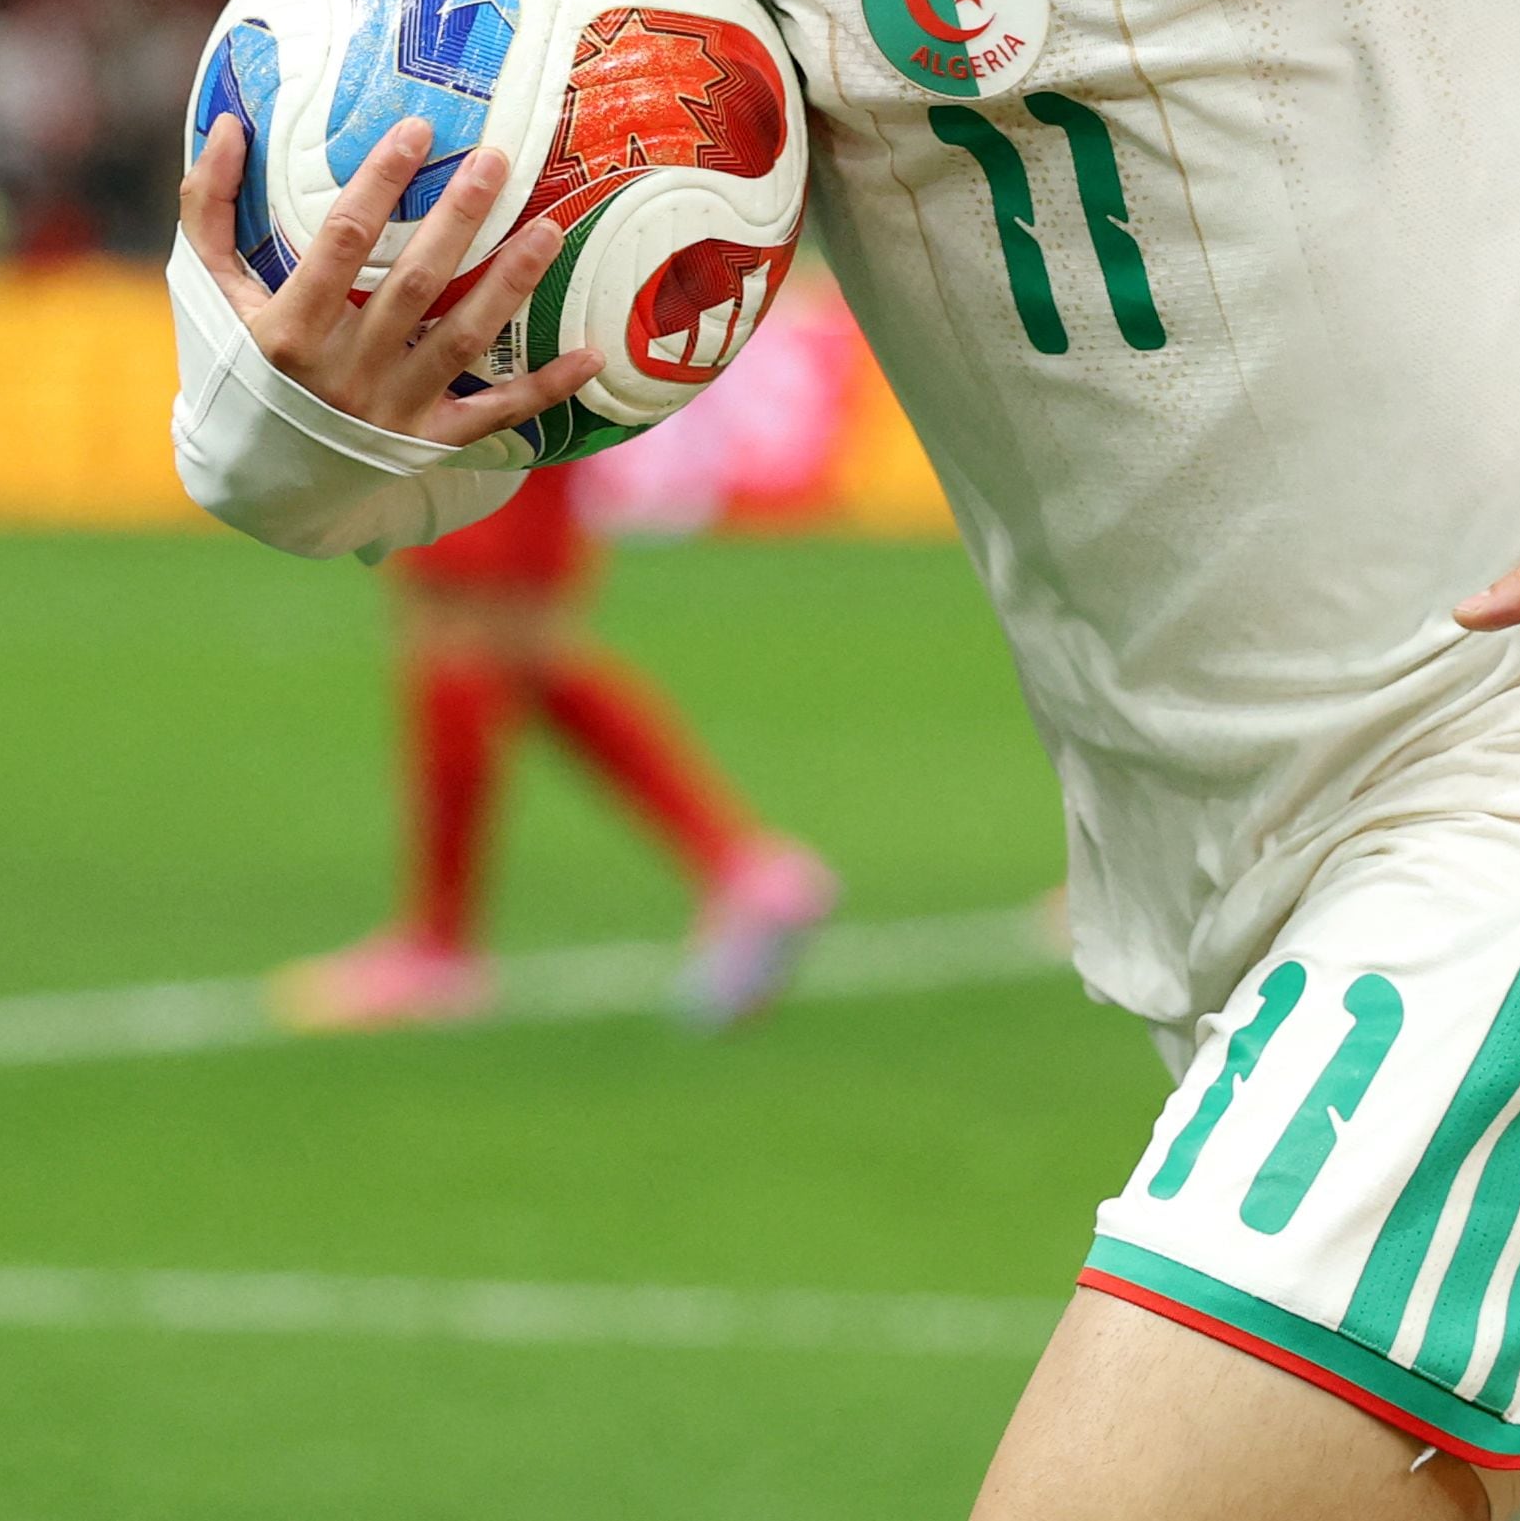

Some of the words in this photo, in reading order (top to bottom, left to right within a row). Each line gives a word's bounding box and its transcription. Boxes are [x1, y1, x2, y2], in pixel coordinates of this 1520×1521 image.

[910, 34, 1026, 80] ALGERIA
[928, 91, 1167, 354] 11
[1148, 960, 1404, 1235] 11
